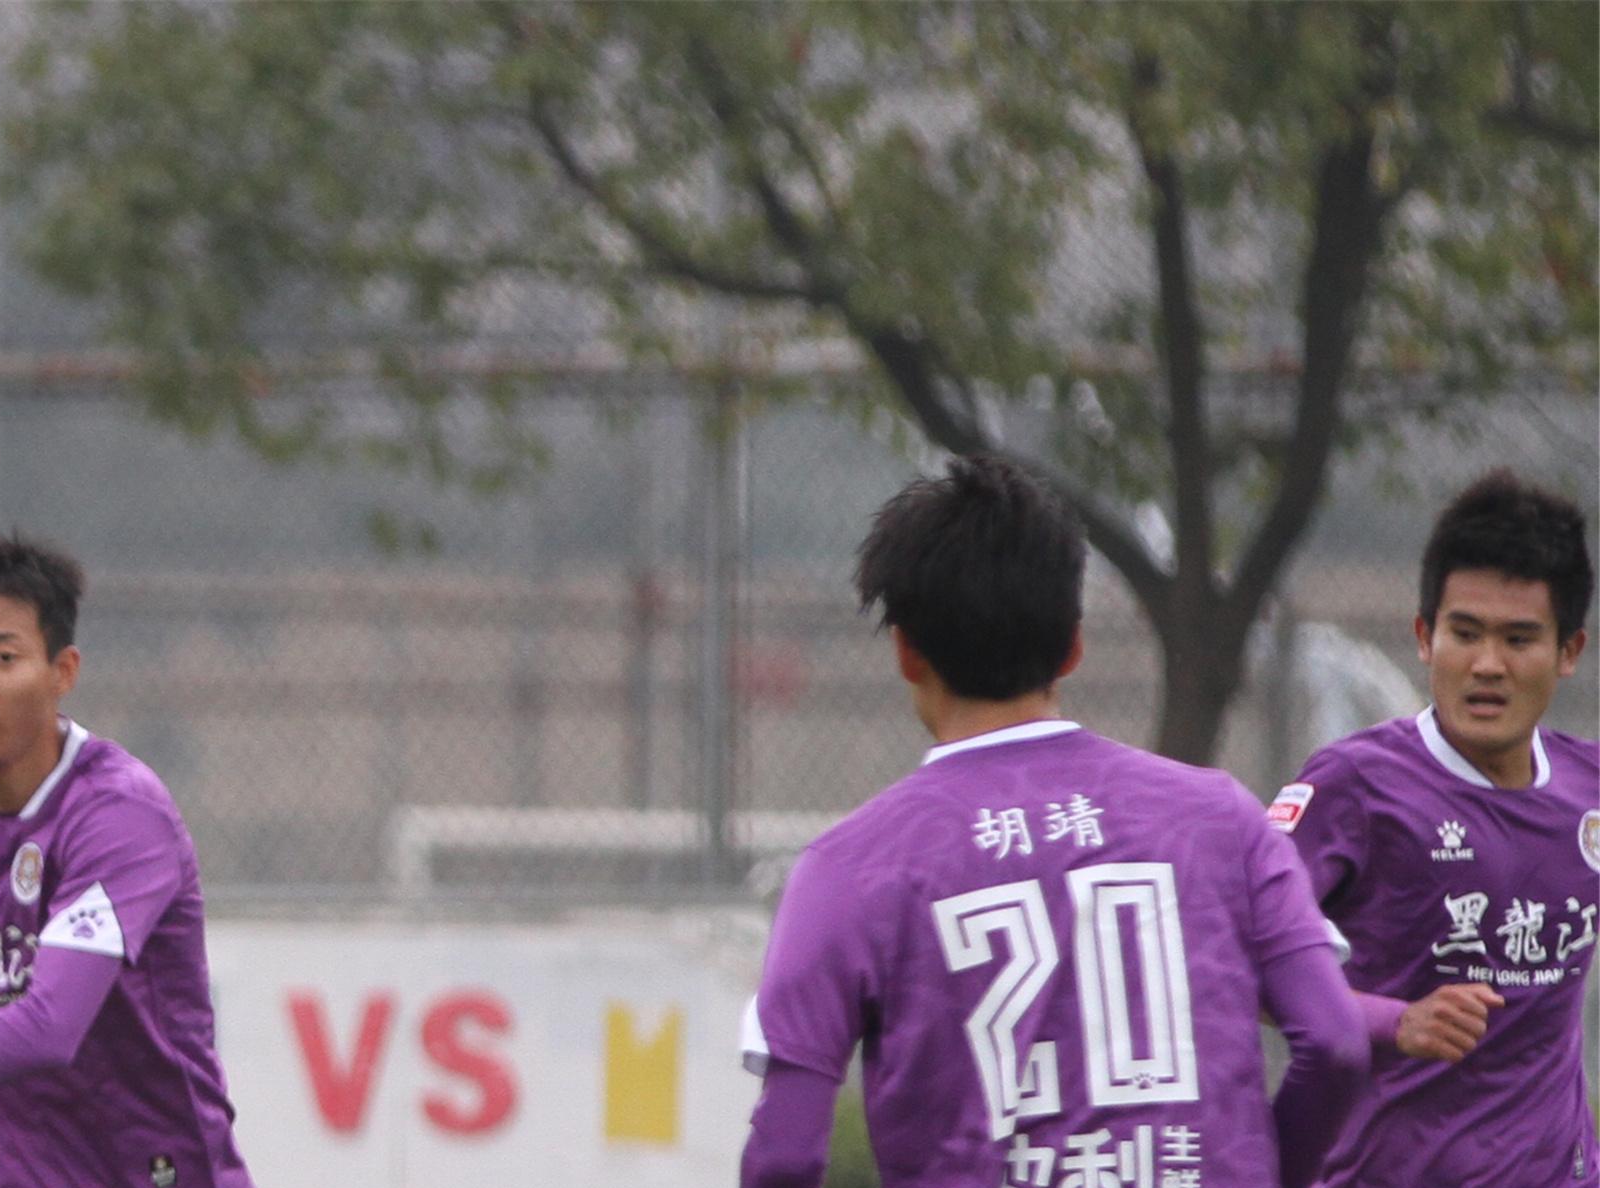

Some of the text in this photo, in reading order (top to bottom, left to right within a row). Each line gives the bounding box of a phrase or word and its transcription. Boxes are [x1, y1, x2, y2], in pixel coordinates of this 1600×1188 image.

[971, 793, 1105, 859] 胡靖
[1431, 848, 1474, 861] KELME
[930, 861, 1200, 1142] 20
[283, 986, 520, 1138] VS
